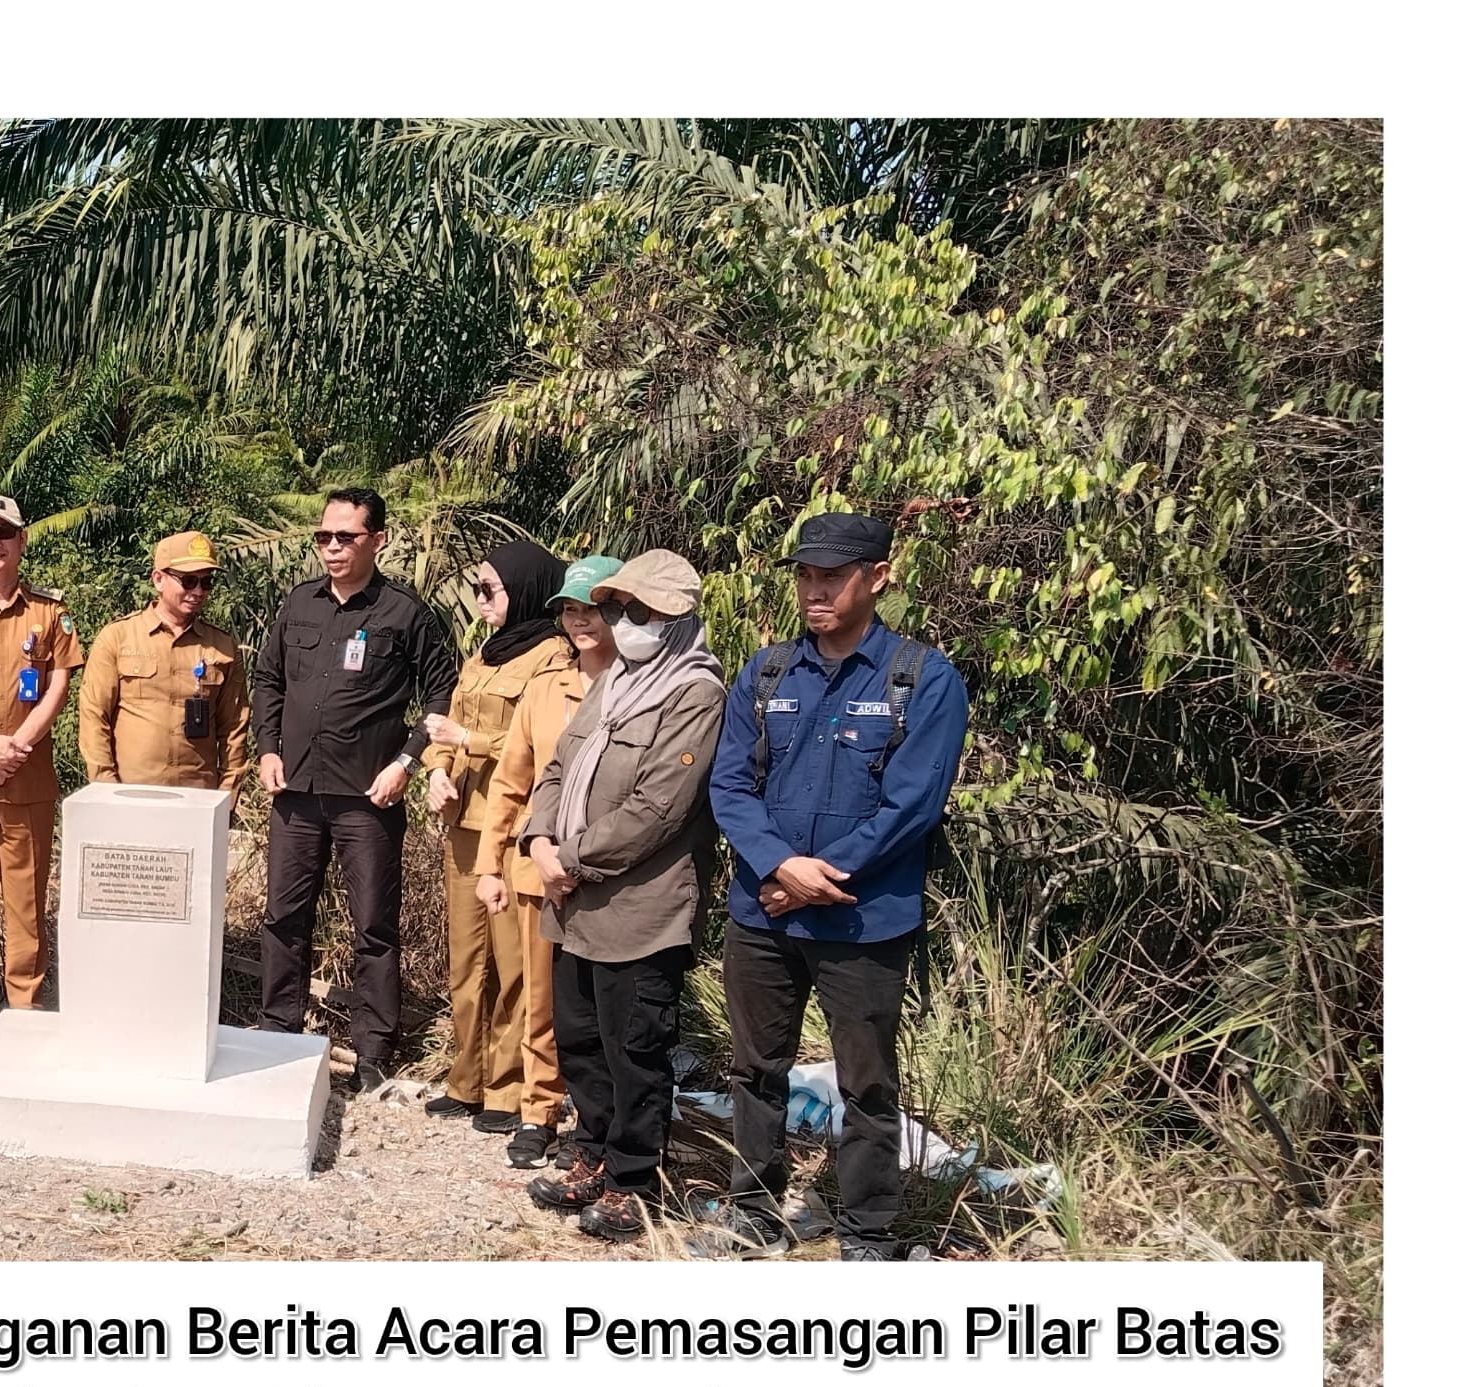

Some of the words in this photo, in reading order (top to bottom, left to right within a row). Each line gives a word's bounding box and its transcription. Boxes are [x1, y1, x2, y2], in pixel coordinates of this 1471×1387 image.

[857, 703, 891, 714] ADWIL
[104, 853, 131, 861] BATAS
[132, 854, 167, 863] DAERAH
[91, 863, 131, 871] KABUPATEN
[131, 864, 154, 872] TANAH
[155, 865, 173, 873] LAUT
[91, 871, 130, 879] KABUPATEN
[154, 874, 180, 882] BUMBU
